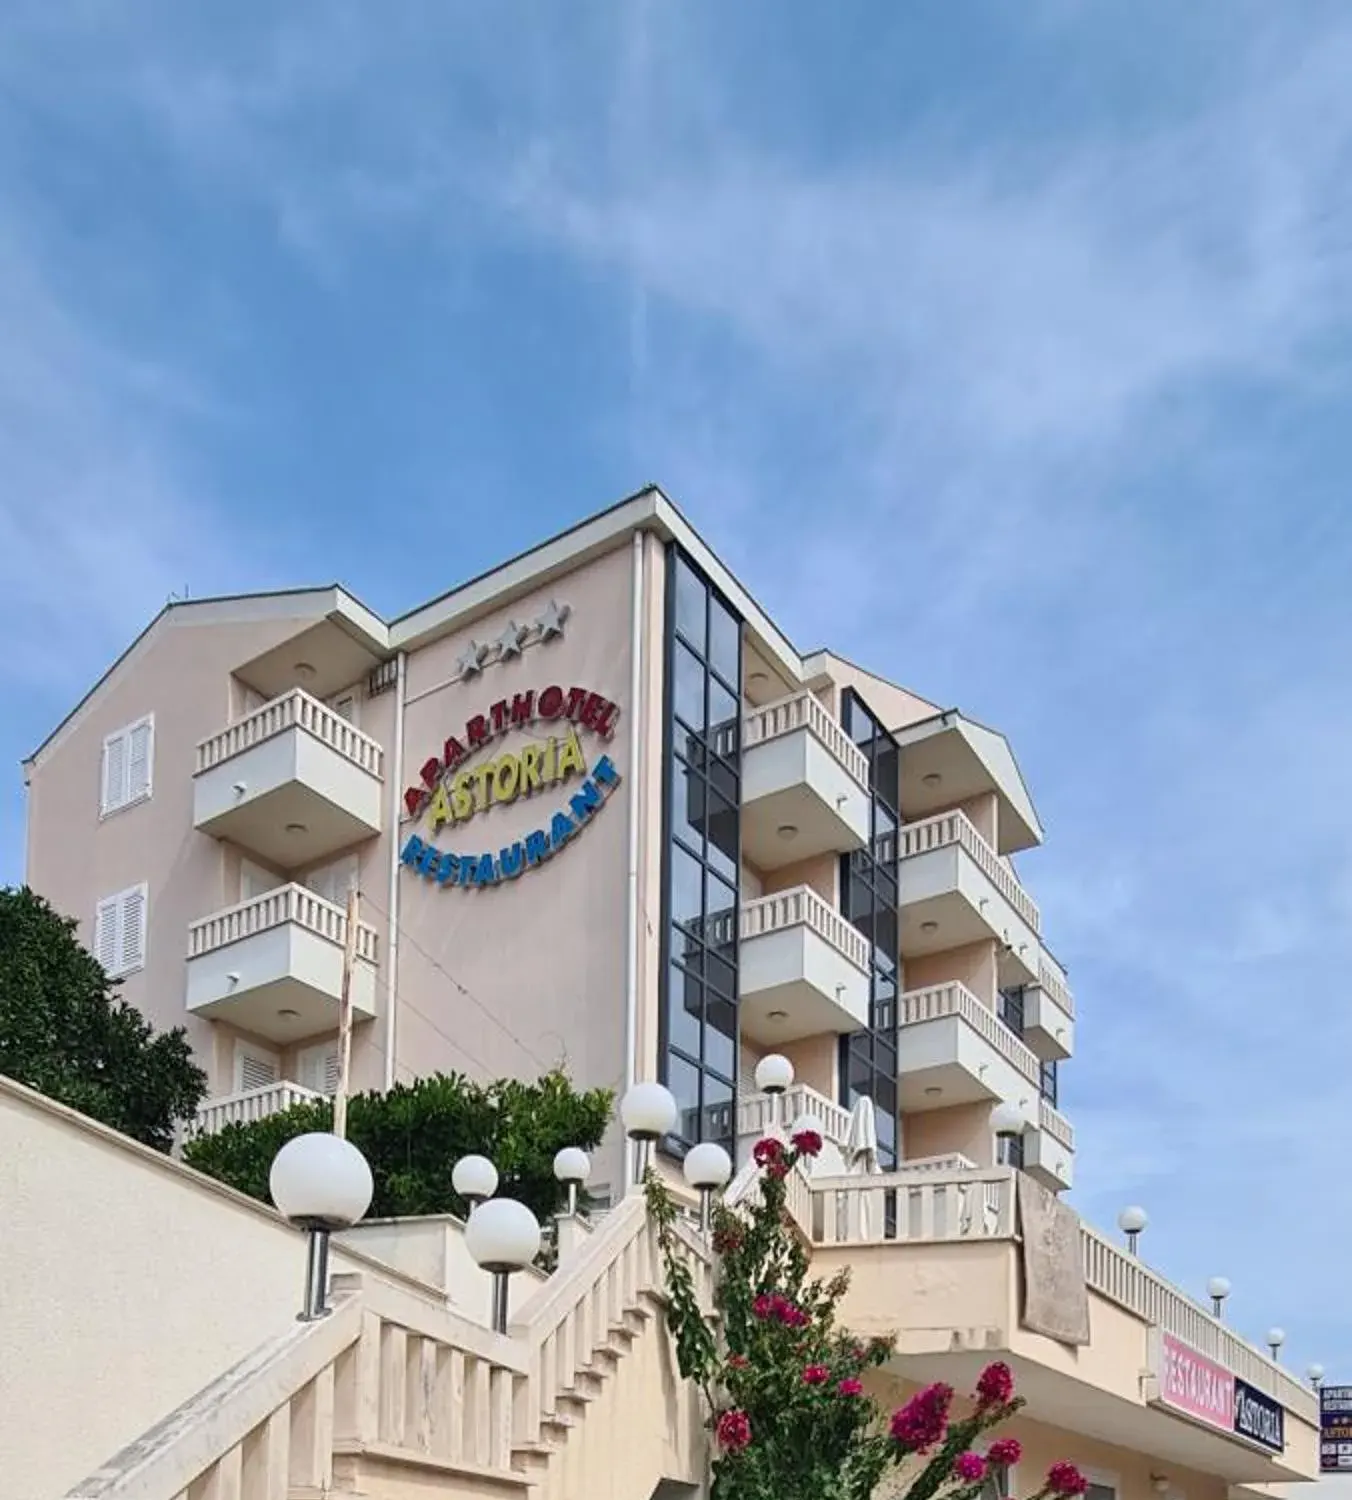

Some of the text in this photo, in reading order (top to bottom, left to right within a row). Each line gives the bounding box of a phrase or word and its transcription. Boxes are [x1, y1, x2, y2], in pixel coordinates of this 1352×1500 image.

[403, 685, 620, 817] APARTHOTEL
[401, 753, 621, 888] RESTAURANT
[1164, 1346, 1232, 1420] RESTAURANT
[1235, 1387, 1282, 1447] ASTORIA
